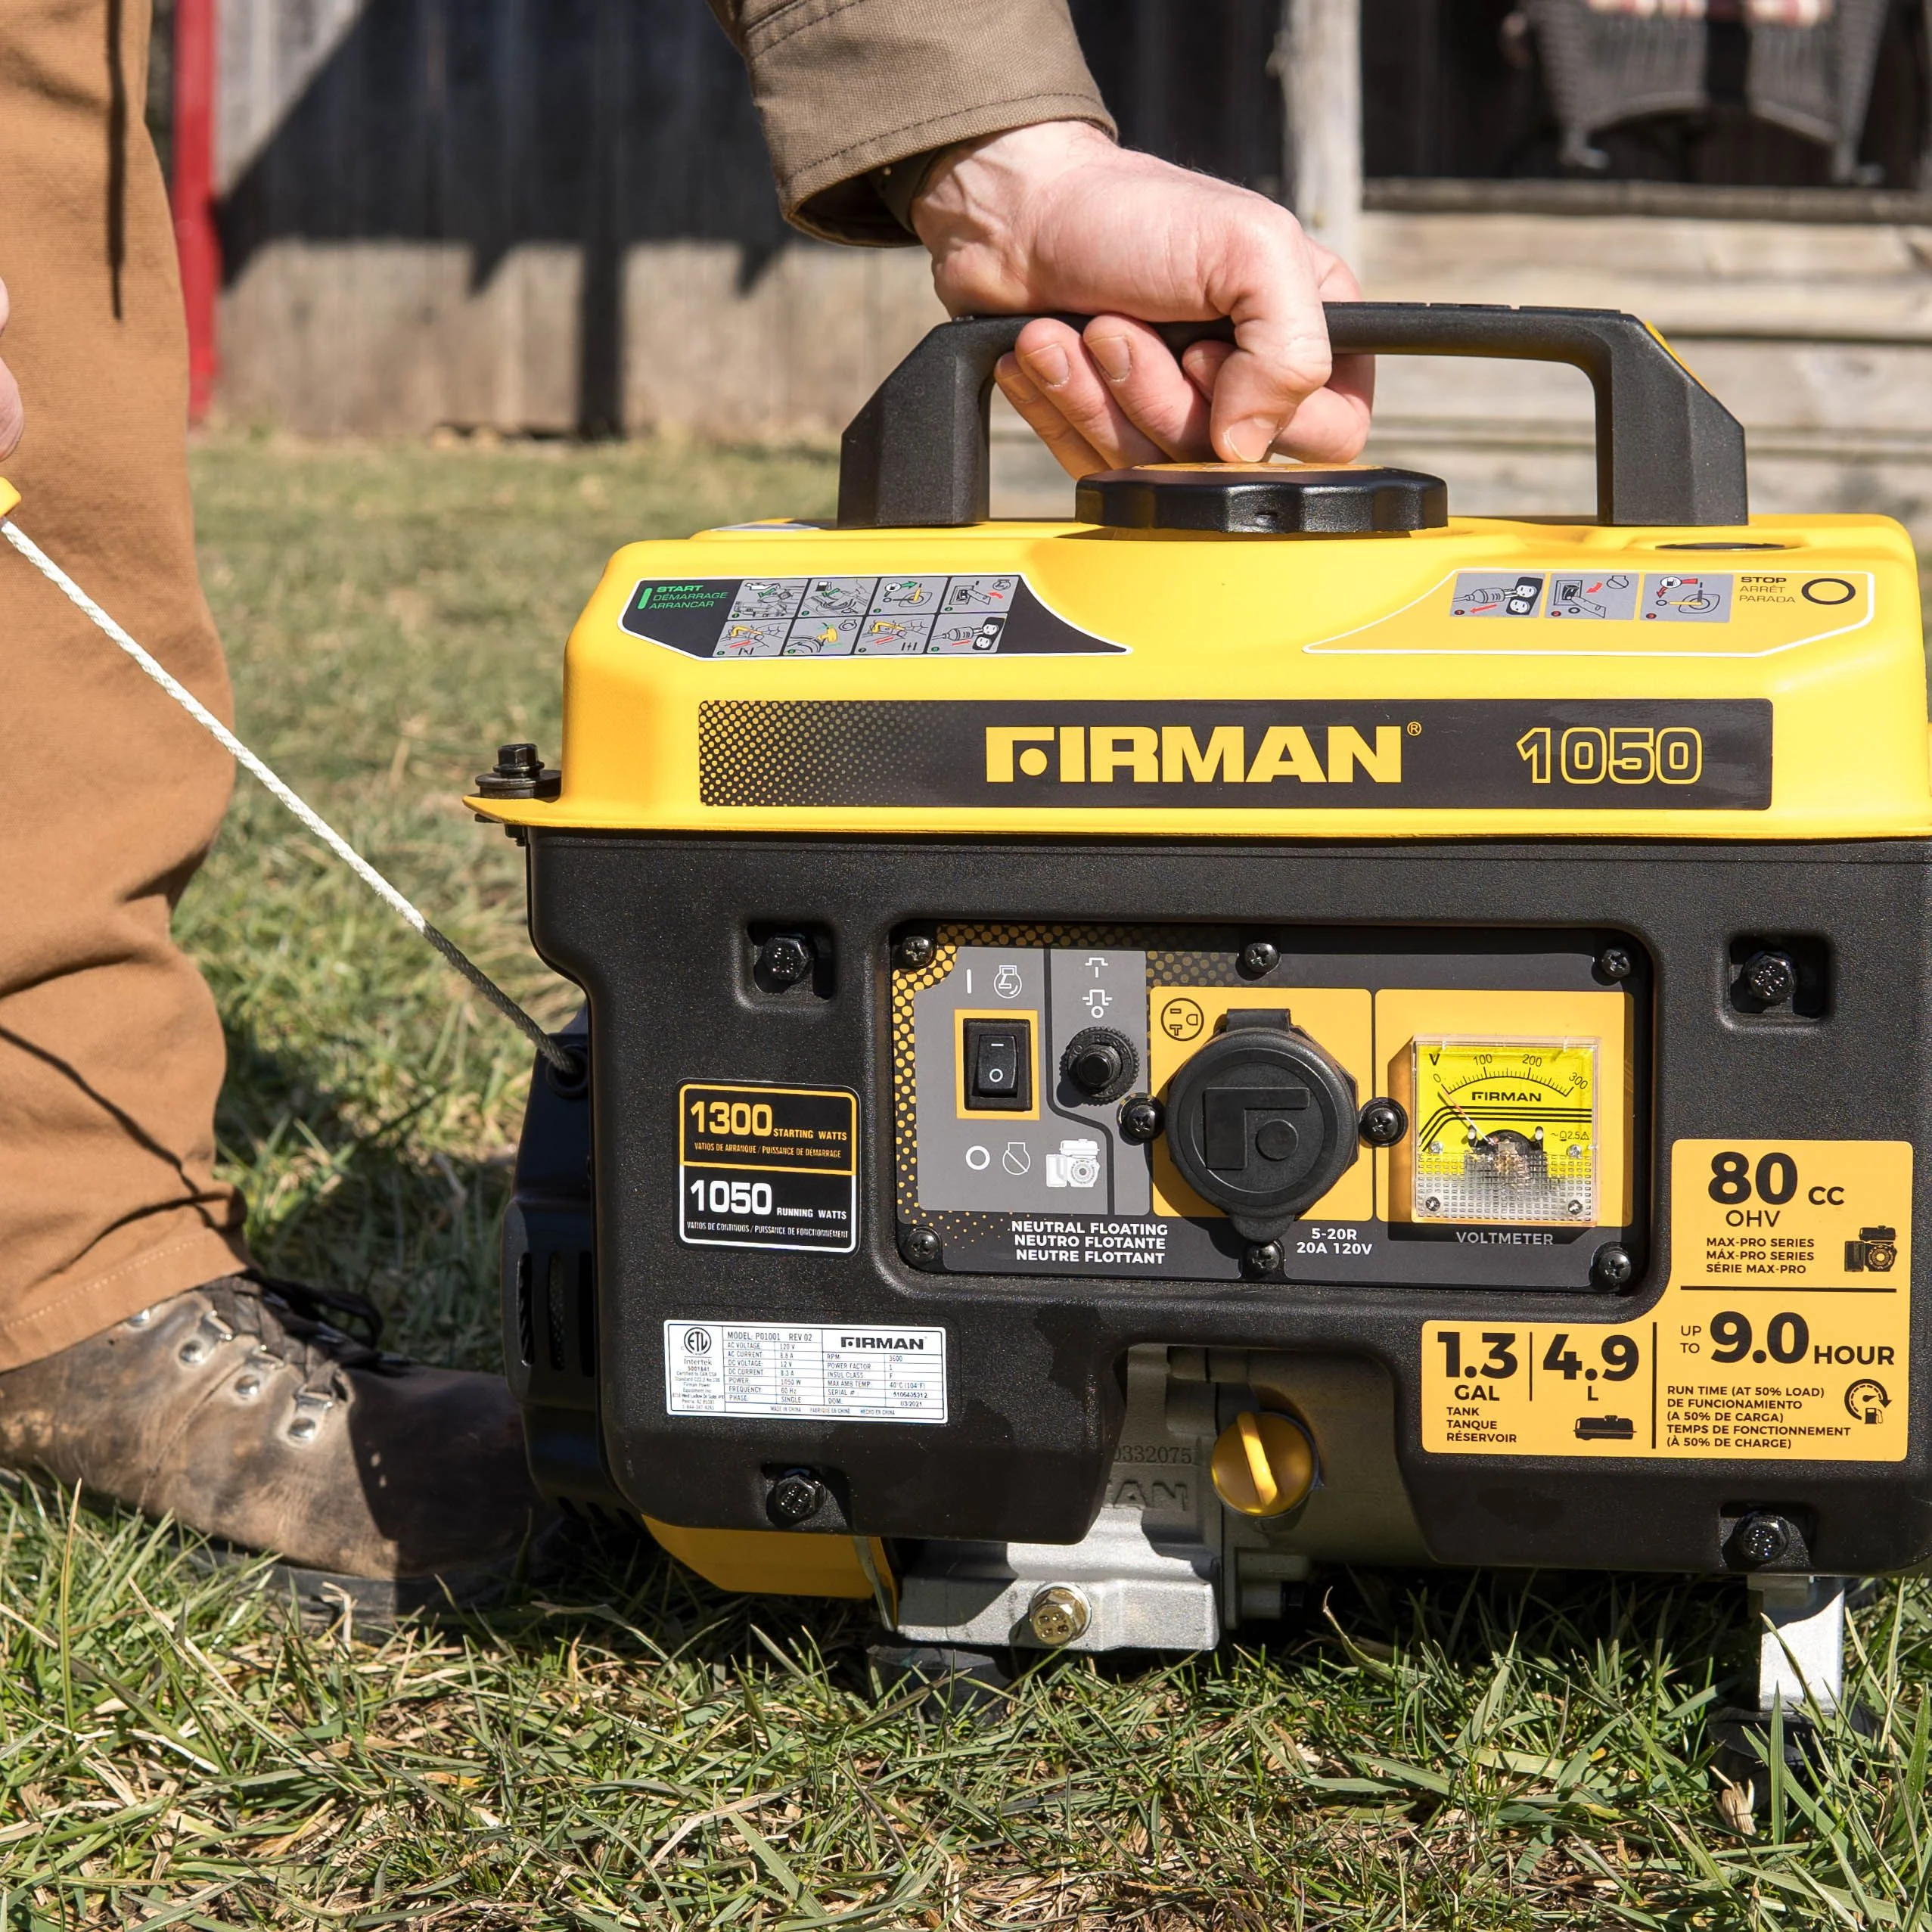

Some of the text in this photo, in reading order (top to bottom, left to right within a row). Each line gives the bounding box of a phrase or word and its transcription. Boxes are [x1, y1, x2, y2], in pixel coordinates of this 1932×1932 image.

[1740, 585, 1786, 593] ARRÊT
[648, 601, 715, 610] ARRANCAR
[1739, 595, 1796, 603] PARADA
[1515, 726, 1703, 785] 1050
[1429, 1053, 1440, 1066] V
[1473, 1054, 1492, 1066] 100
[1522, 1054, 1542, 1067] 200
[1433, 1073, 1442, 1083] 0
[1568, 1072, 1589, 1090] 300
[1472, 1092, 1542, 1102] FIRMAN
[690, 1101, 847, 1141] 1300 STARTING WATTS
[694, 1142, 714, 1151] VATIOS
[716, 1143, 724, 1151] DE
[725, 1144, 756, 1154] ARRANQUE
[762, 1145, 794, 1156] PUISSANCE
[796, 1148, 803, 1156] DE
[1708, 1151, 1798, 1205] 80
[690, 1179, 847, 1219] 1050 RUNNING WATTS
[1725, 1210, 1781, 1228] OHV
[687, 1221, 707, 1230] VATIOS
[707, 1222, 716, 1231] DE
[716, 1223, 750, 1232] CONTINUOS
[754, 1225, 786, 1235] PUISSANCE
[787, 1227, 795, 1235] DE
[797, 1228, 848, 1238] FONCTIONNEMENT
[1011, 1220, 1168, 1236] NEUTRAL FLOATING
[1311, 1228, 1357, 1241] 5-20R
[1014, 1234, 1166, 1250] NEUTRO FLOTANTE
[1455, 1231, 1554, 1246] VOLTMETER
[1707, 1238, 1815, 1248] MAX-PRO SERIES
[1297, 1242, 1373, 1255] 20A 120V
[1707, 1249, 1815, 1261] MÁX-PRO SERIES
[1016, 1249, 1165, 1265] NEUTRE FLOTTANT
[1707, 1262, 1806, 1275] SÉRIE MAX-PRO
[756, 1332, 780, 1341] P01001
[789, 1333, 803, 1341] REV
[1680, 1325, 1701, 1337] UP
[1710, 1310, 1895, 1365] 9.0 HOUR
[1437, 1331, 1518, 1379] 1.3
[1680, 1343, 1700, 1354] TO
[1543, 1334, 1639, 1382] 4.9
[1454, 1384, 1499, 1401] GAL
[1588, 1385, 1598, 1401] L
[1667, 1385, 1825, 1399] RUN TIME (AT 50% LOAD)
[1667, 1398, 1802, 1410] DE FUNCIONAMIENTO
[1446, 1406, 1480, 1416] TANK
[1666, 1411, 1784, 1423] (A 50% DE CARGA)
[1446, 1419, 1497, 1430] TANQUE
[1666, 1424, 1851, 1436] TEMPS DE FONCTIONNEMENT
[1446, 1430, 1517, 1443] RÉSERVOIR
[1666, 1435, 1791, 1449] (À 50% DE CHARGE)
